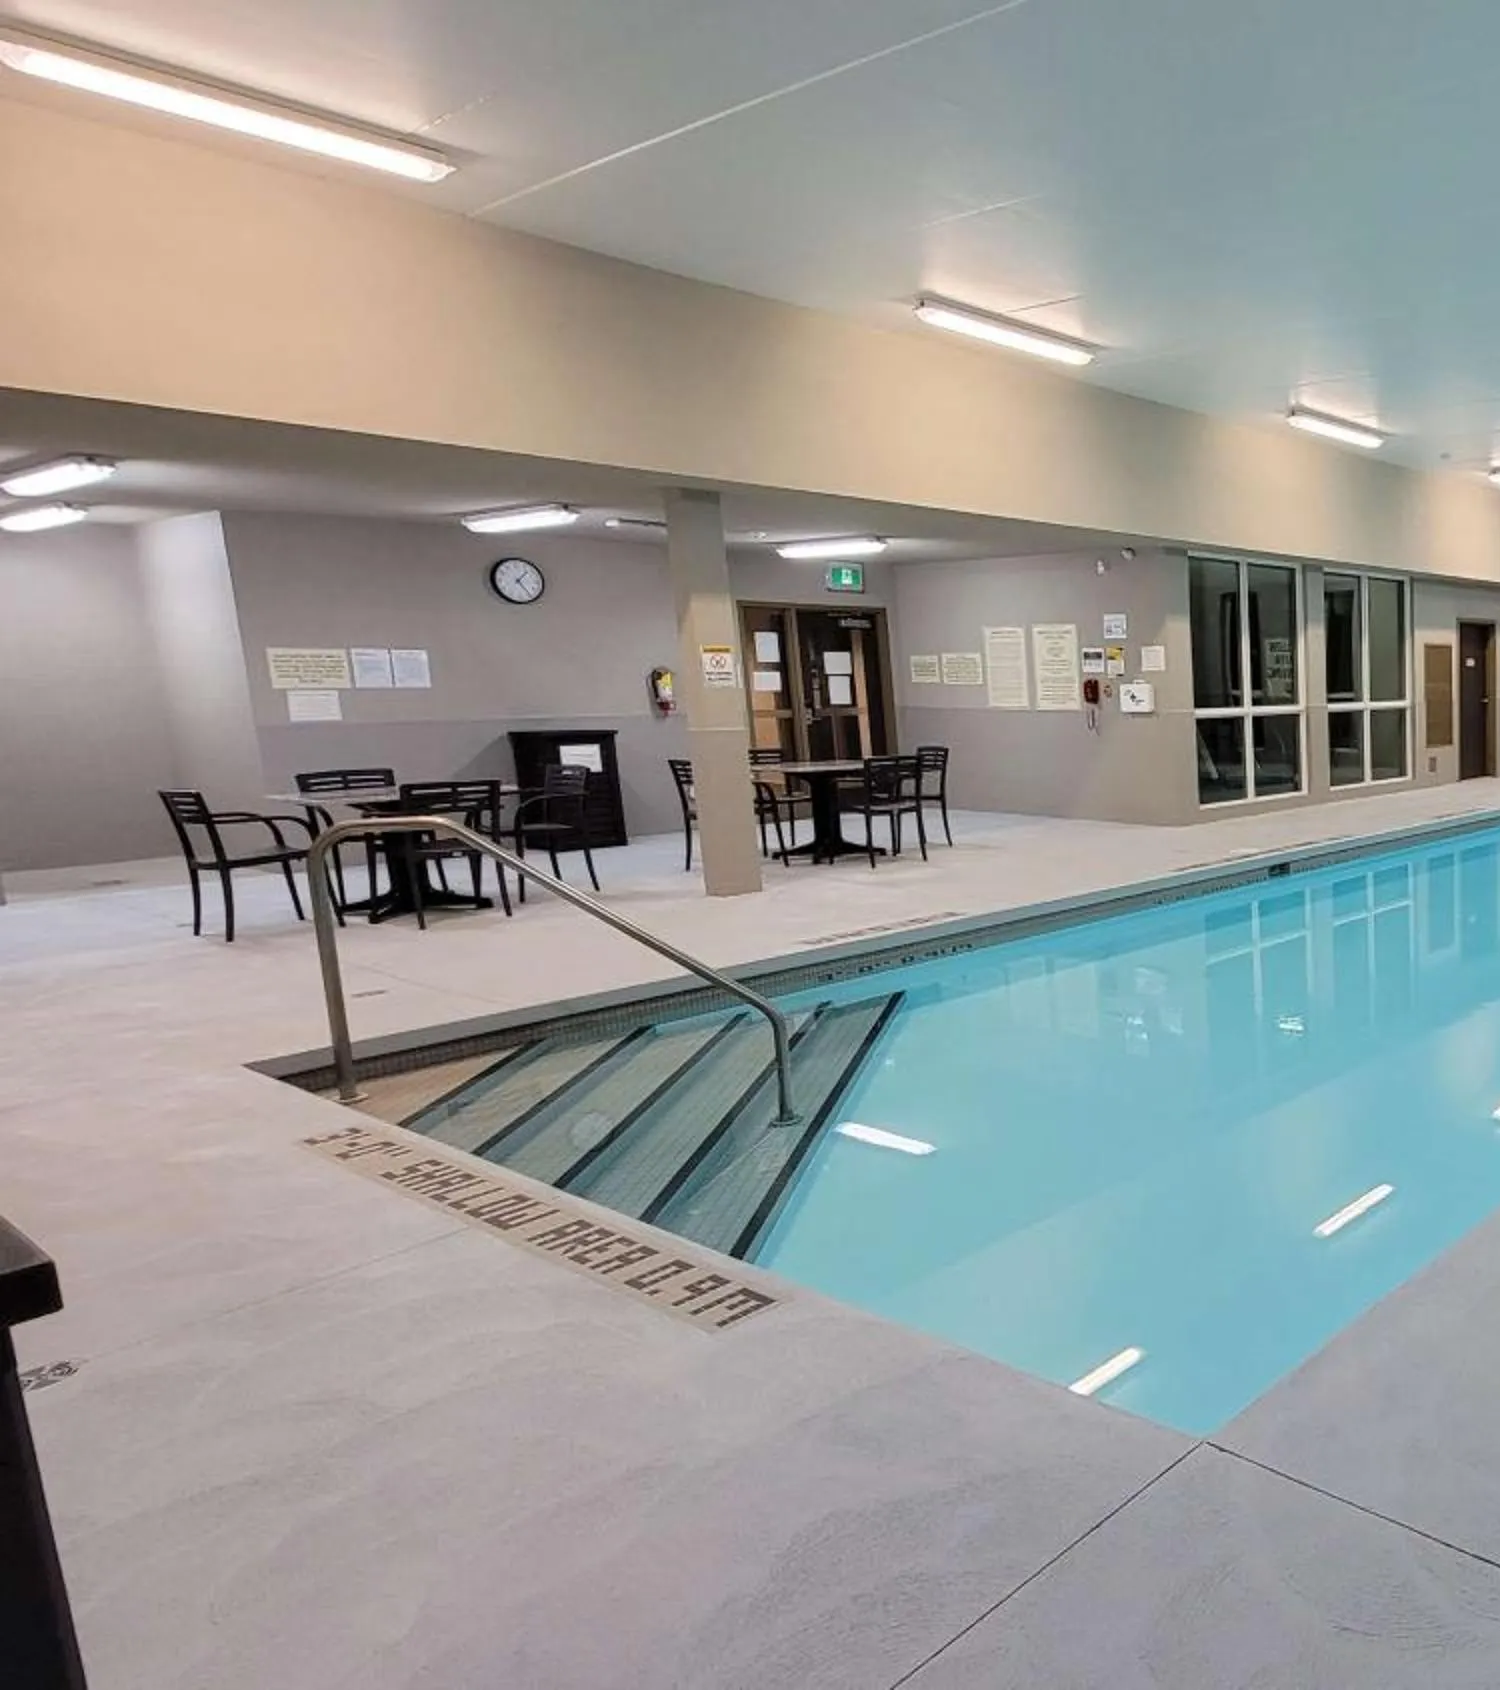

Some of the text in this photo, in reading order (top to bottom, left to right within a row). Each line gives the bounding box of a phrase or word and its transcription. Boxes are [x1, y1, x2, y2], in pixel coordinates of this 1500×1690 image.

[380, 1159, 562, 1231] SHALLOW
[526, 1219, 660, 1275] AREA
[623, 1259, 777, 1328] 0.9M
